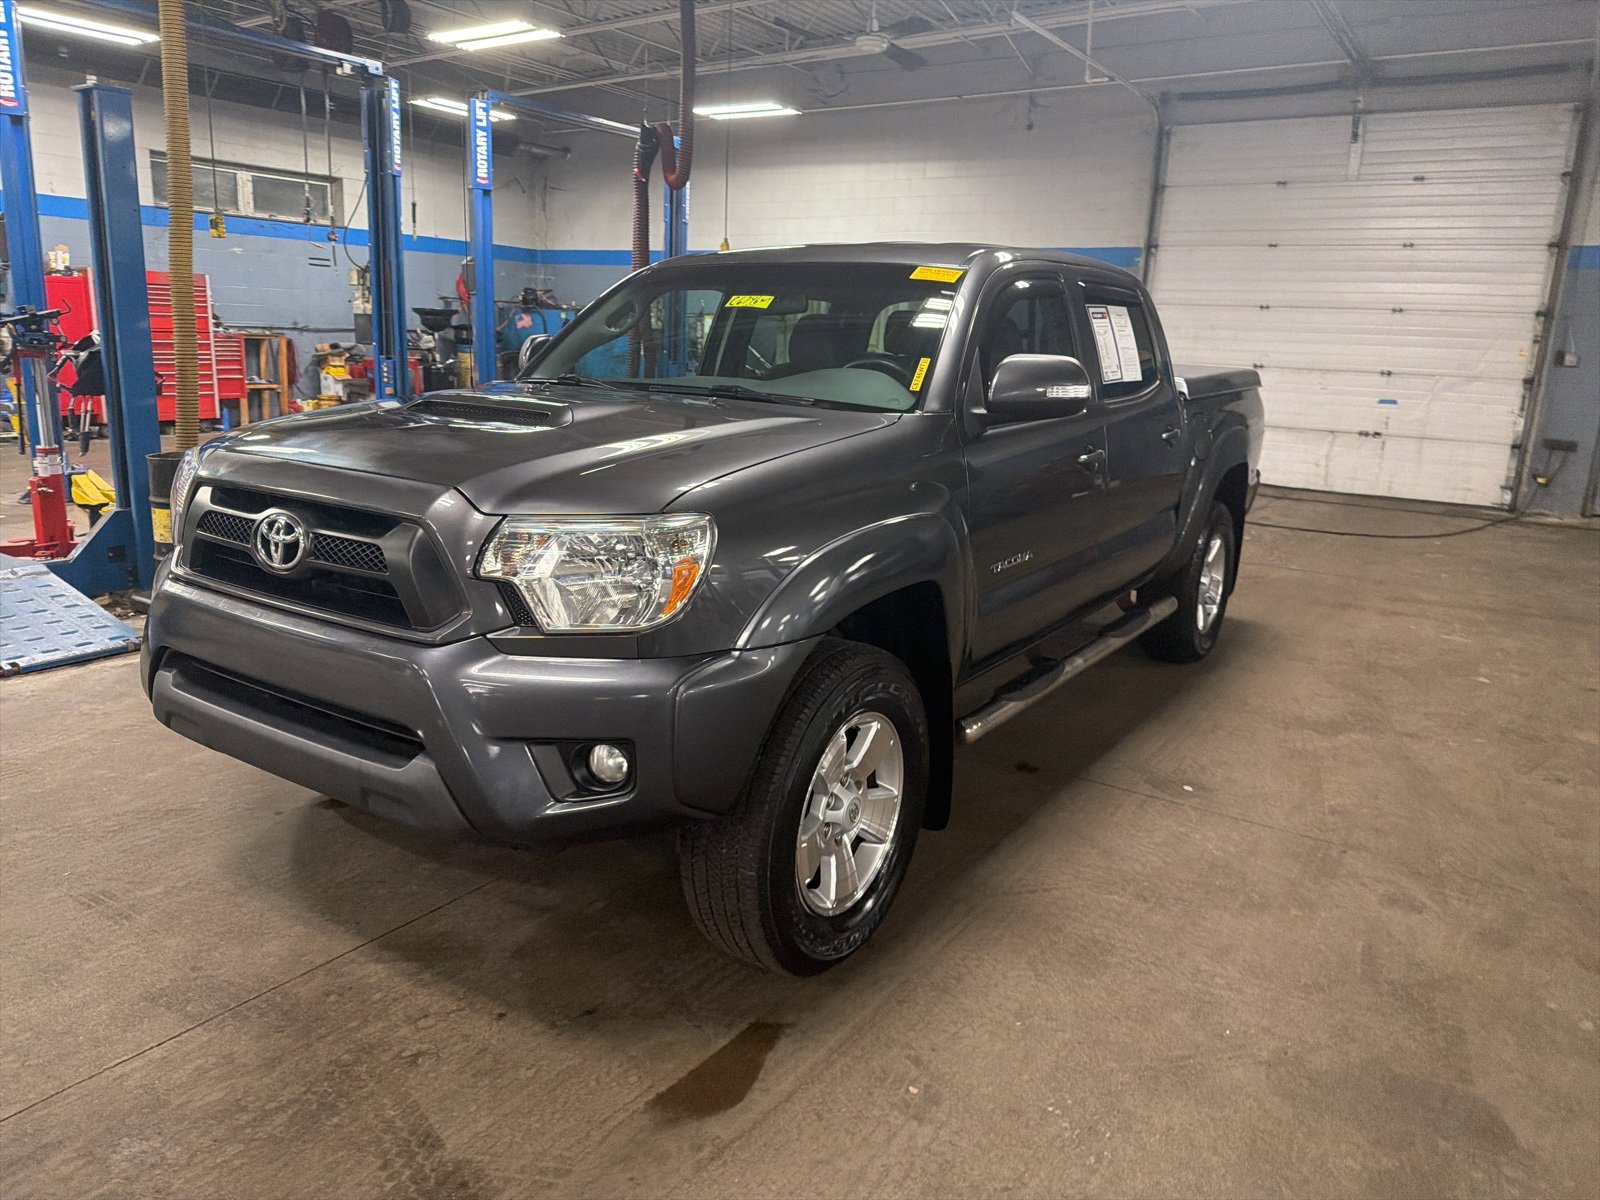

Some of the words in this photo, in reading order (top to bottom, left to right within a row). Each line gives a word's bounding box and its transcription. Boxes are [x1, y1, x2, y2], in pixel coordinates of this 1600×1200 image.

[391, 81, 400, 109] LIFT
[475, 100, 487, 127] LIFT
[393, 112, 402, 164] ROTARY
[476, 129, 489, 178] ROTARY
[990, 549, 1034, 574] TACOMA
